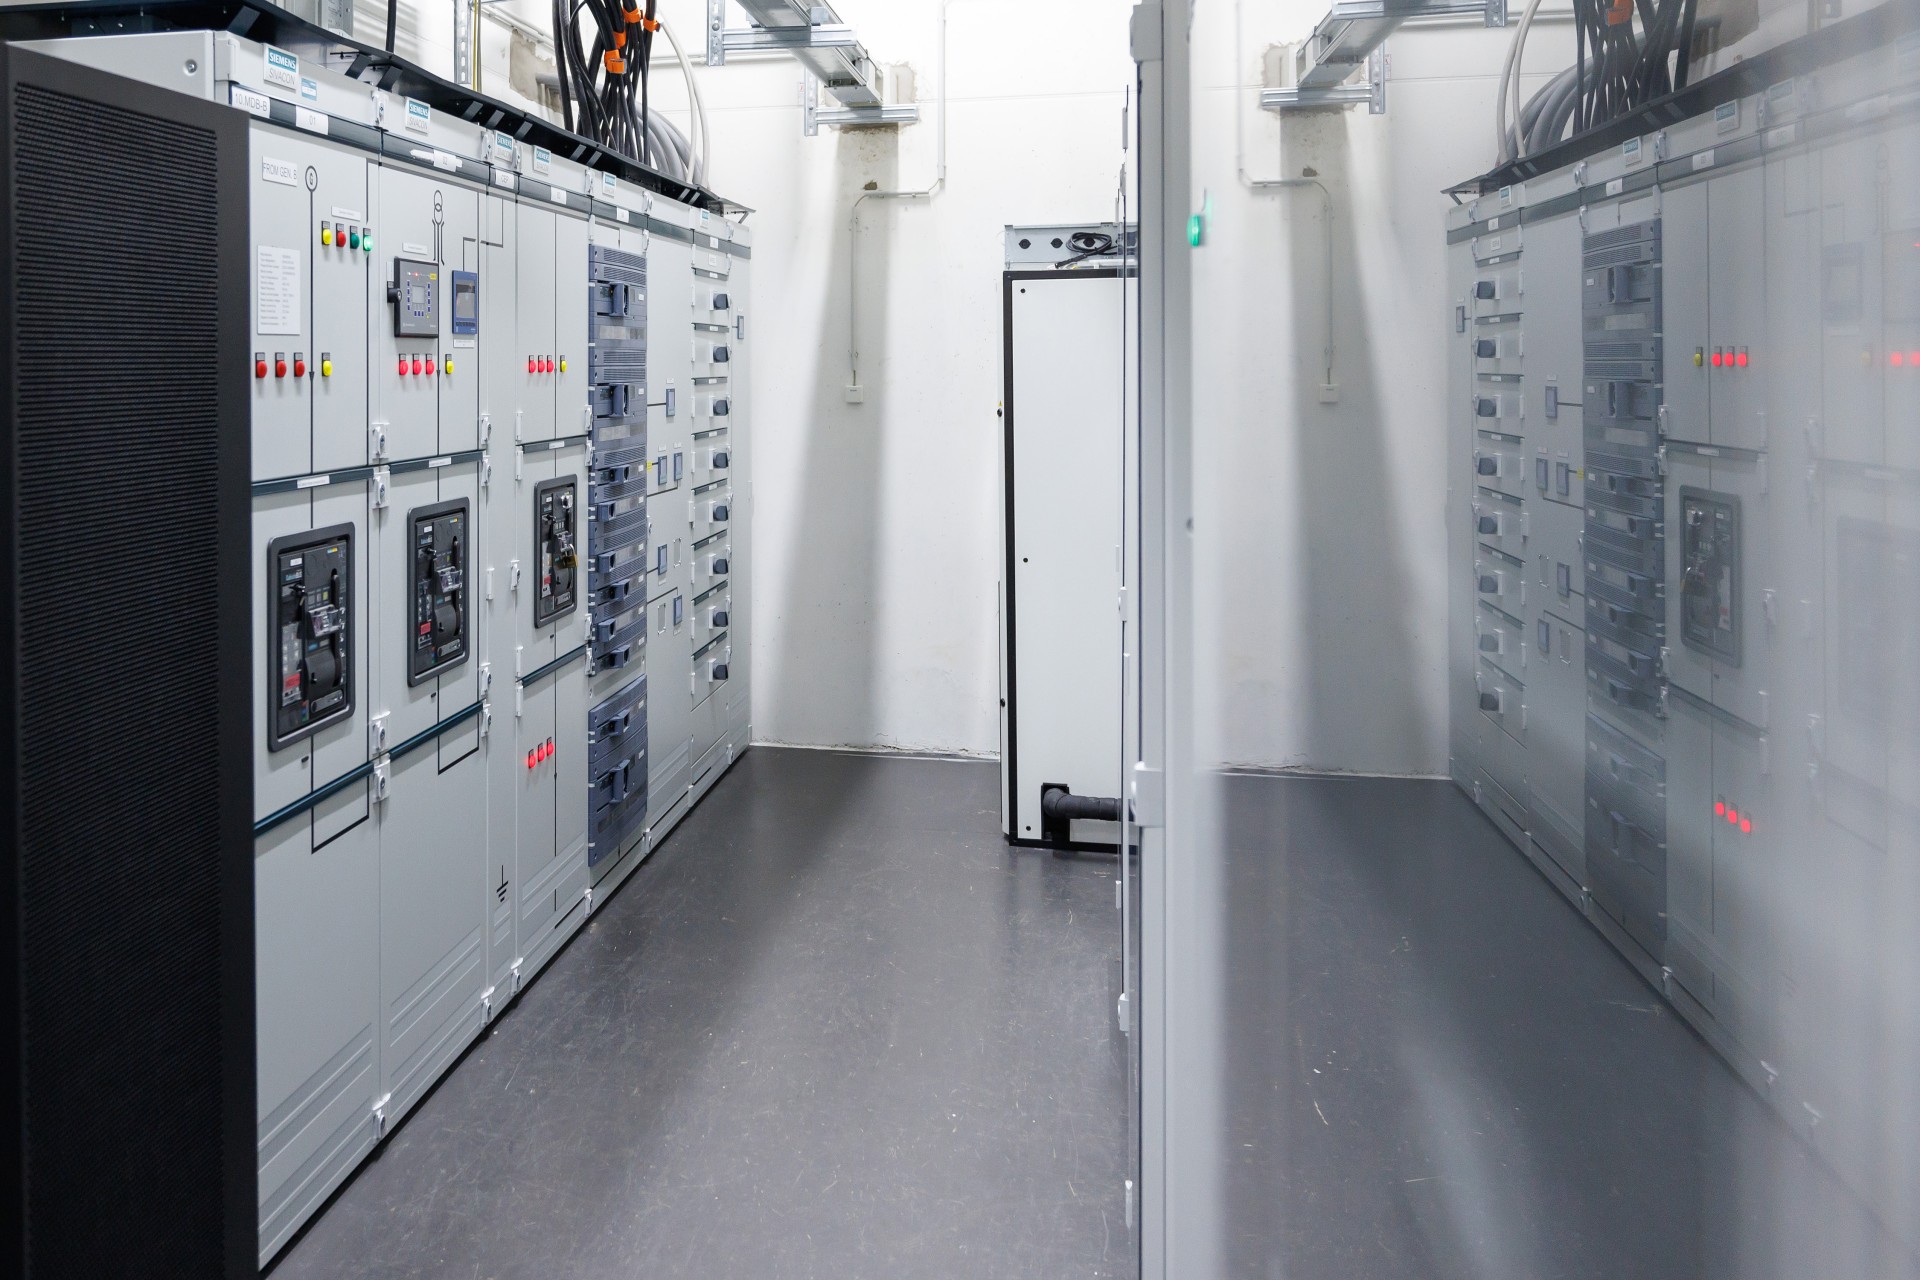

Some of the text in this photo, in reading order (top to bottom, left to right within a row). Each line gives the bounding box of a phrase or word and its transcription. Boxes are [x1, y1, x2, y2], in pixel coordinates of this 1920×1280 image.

[269, 51, 297, 70] SIEMENS
[269, 67, 296, 86] SIVACON
[235, 93, 268, 112] 10.MDB-B
[409, 103, 429, 117] SIEMENS
